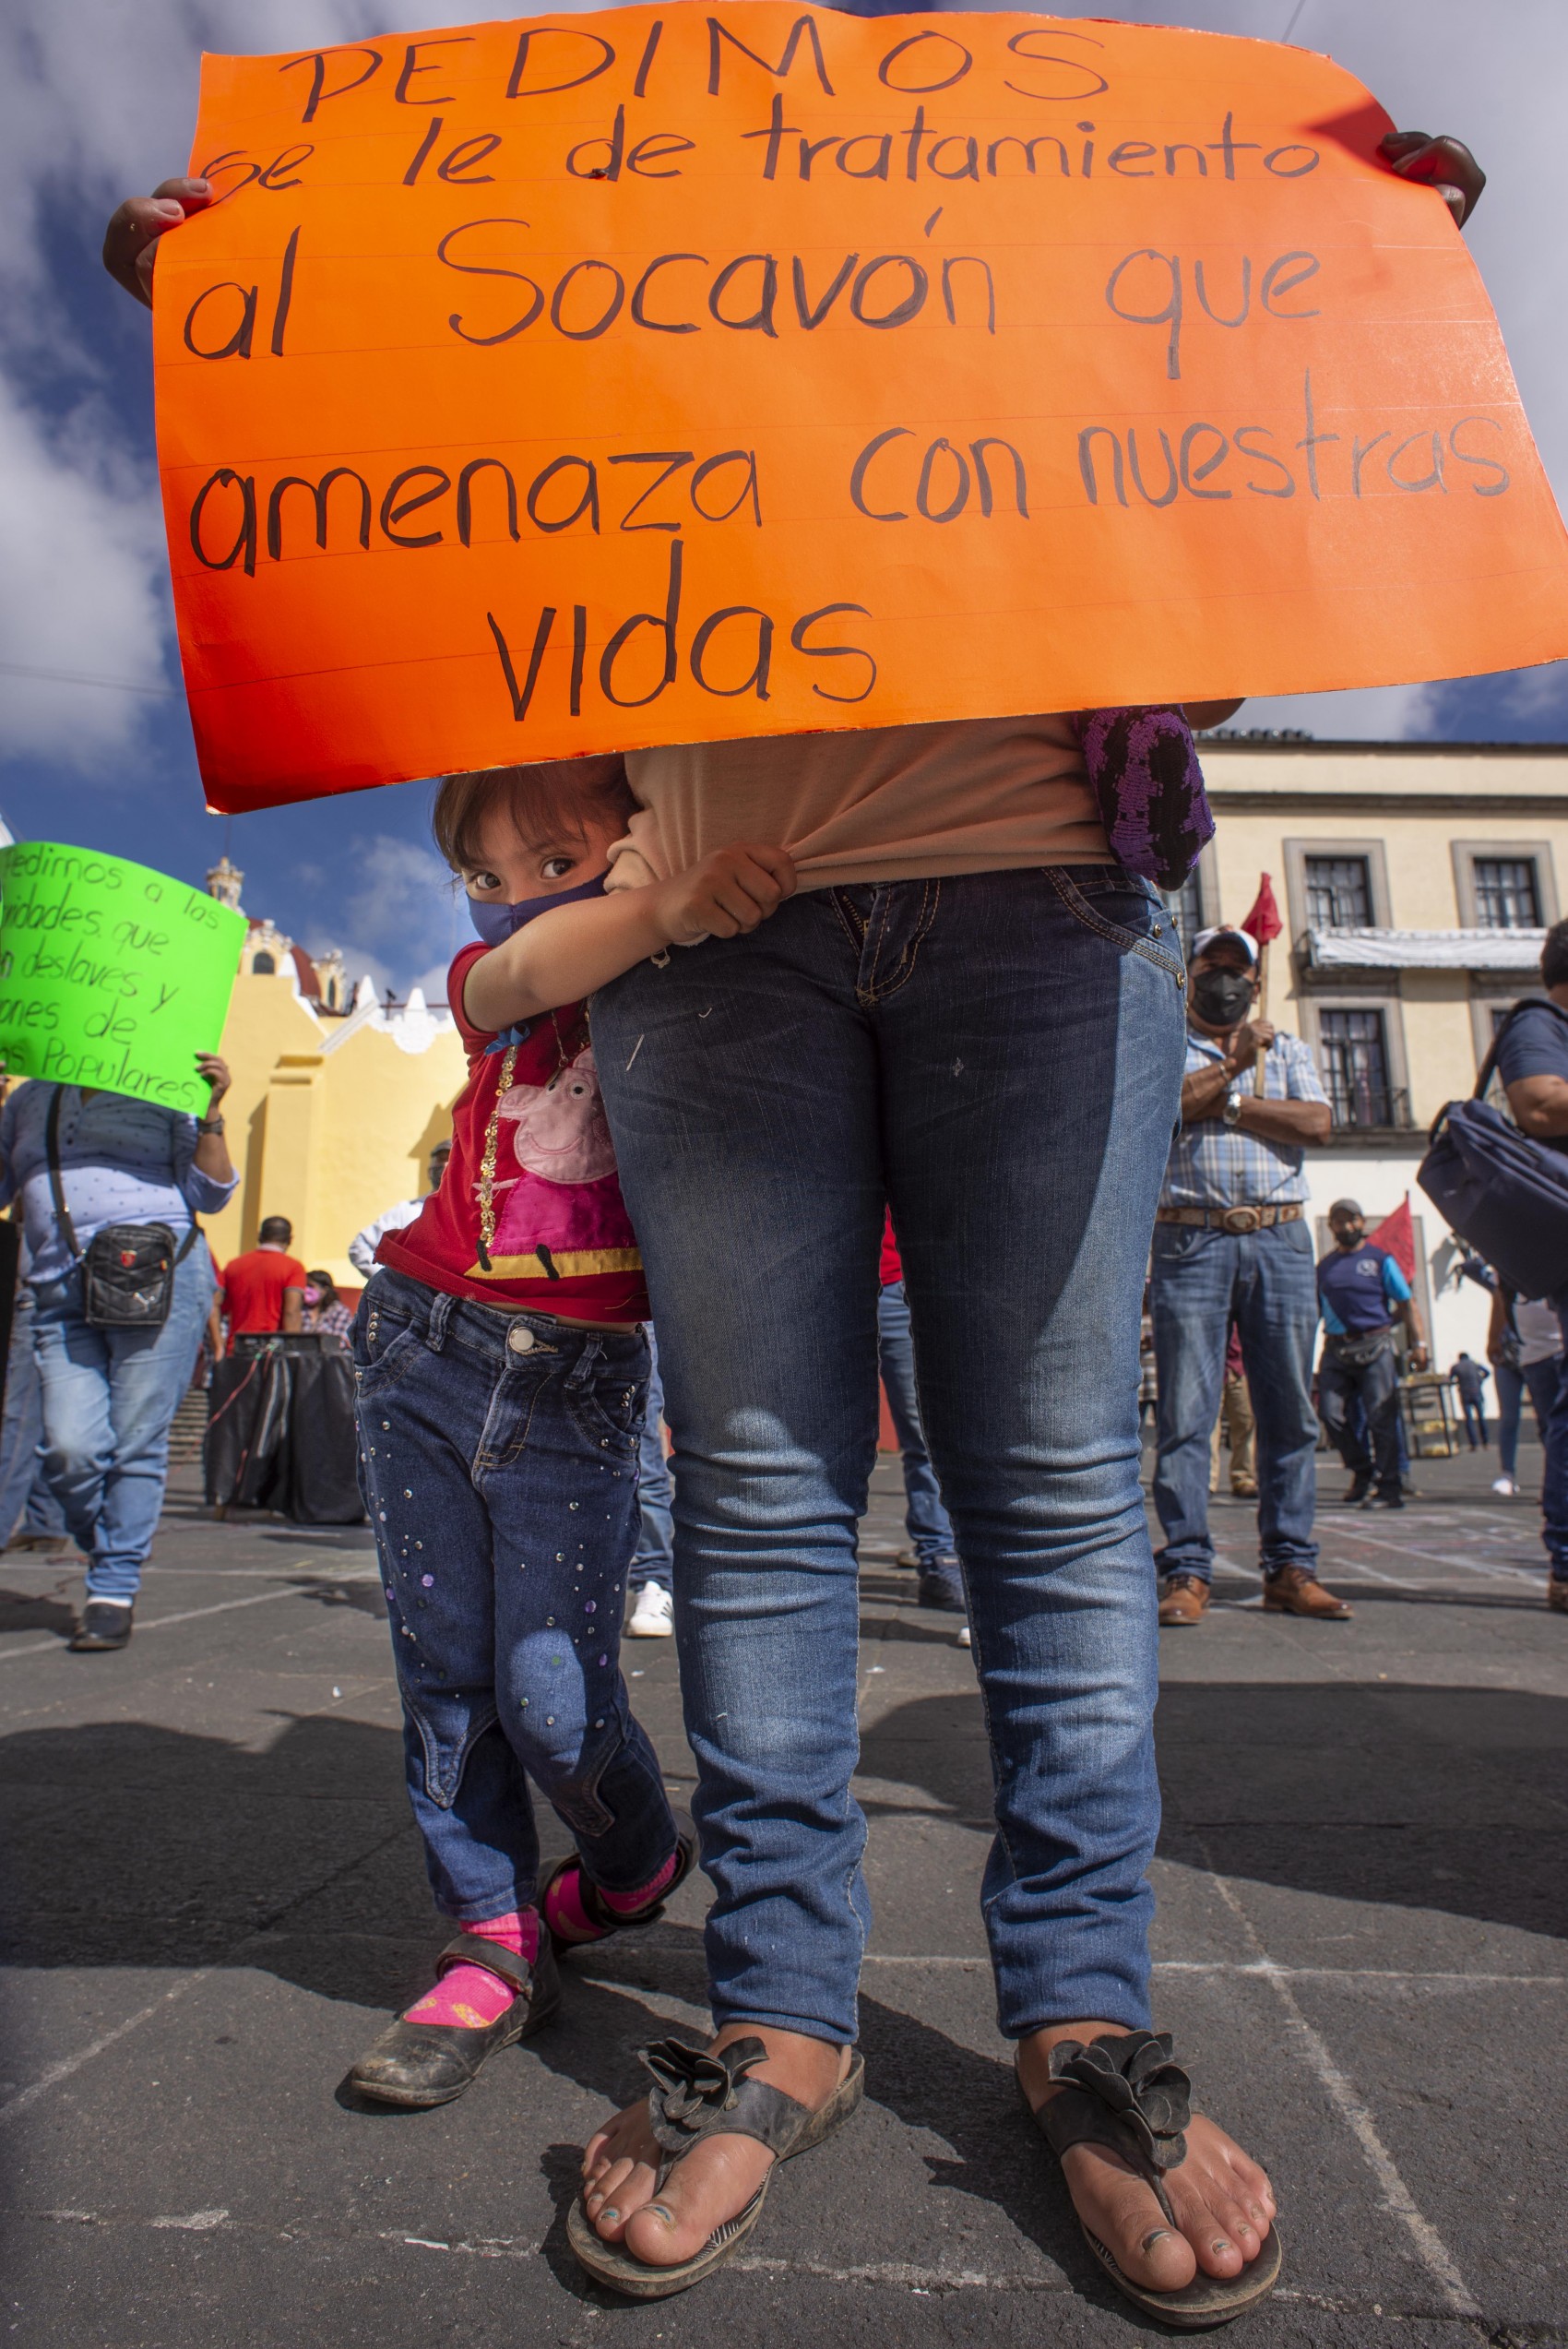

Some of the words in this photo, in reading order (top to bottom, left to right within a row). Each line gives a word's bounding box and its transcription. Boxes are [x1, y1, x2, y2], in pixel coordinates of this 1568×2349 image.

[279, 14, 1109, 124] PEDIMOS
[198, 143, 315, 209] se
[402, 117, 503, 186] le
[565, 103, 696, 183] de
[740, 92, 1320, 183] tratamiento
[184, 224, 302, 361] al
[436, 206, 995, 347] Socavón
[1107, 248, 1323, 380] que
[189, 449, 763, 578] amenaza
[1077, 366, 1511, 508] nuestras
[113, 920, 170, 956] que
[145, 882, 163, 903] a
[184, 891, 220, 930] las
[24, 935, 144, 998] deslaves
[150, 982, 180, 1014] y
[83, 996, 137, 1045] de
